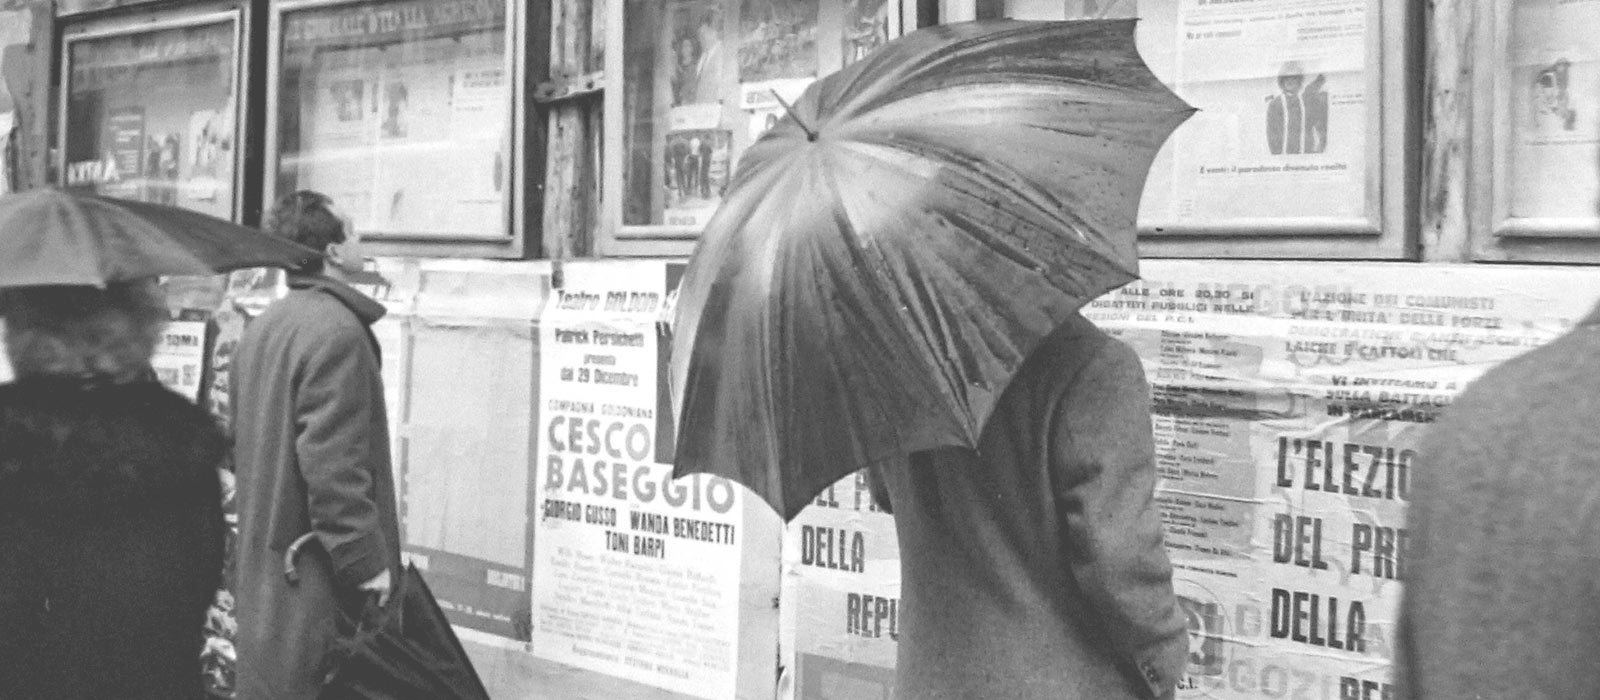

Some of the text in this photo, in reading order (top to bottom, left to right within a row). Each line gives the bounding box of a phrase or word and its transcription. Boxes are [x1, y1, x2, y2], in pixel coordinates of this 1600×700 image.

[556, 290, 600, 310] Teatro
[1120, 288, 1150, 297] ALLE
[1159, 289, 1185, 298] ORE
[554, 327, 589, 343] Patrick
[560, 367, 639, 387] dal 29 Dicembre
[548, 399, 653, 419] COMPAGNIA GOLDONIANA
[548, 415, 651, 461] CESCO
[545, 453, 735, 514] BASEGGIO
[544, 498, 582, 522] GIORGIO
[629, 510, 670, 535] WANDA
[673, 517, 735, 545] BENEDETTI
[605, 530, 665, 559] TONI BARPI
[801, 524, 865, 573] DELLA
[1273, 513, 1329, 571] DEL
[1270, 587, 1366, 652] DELLA
